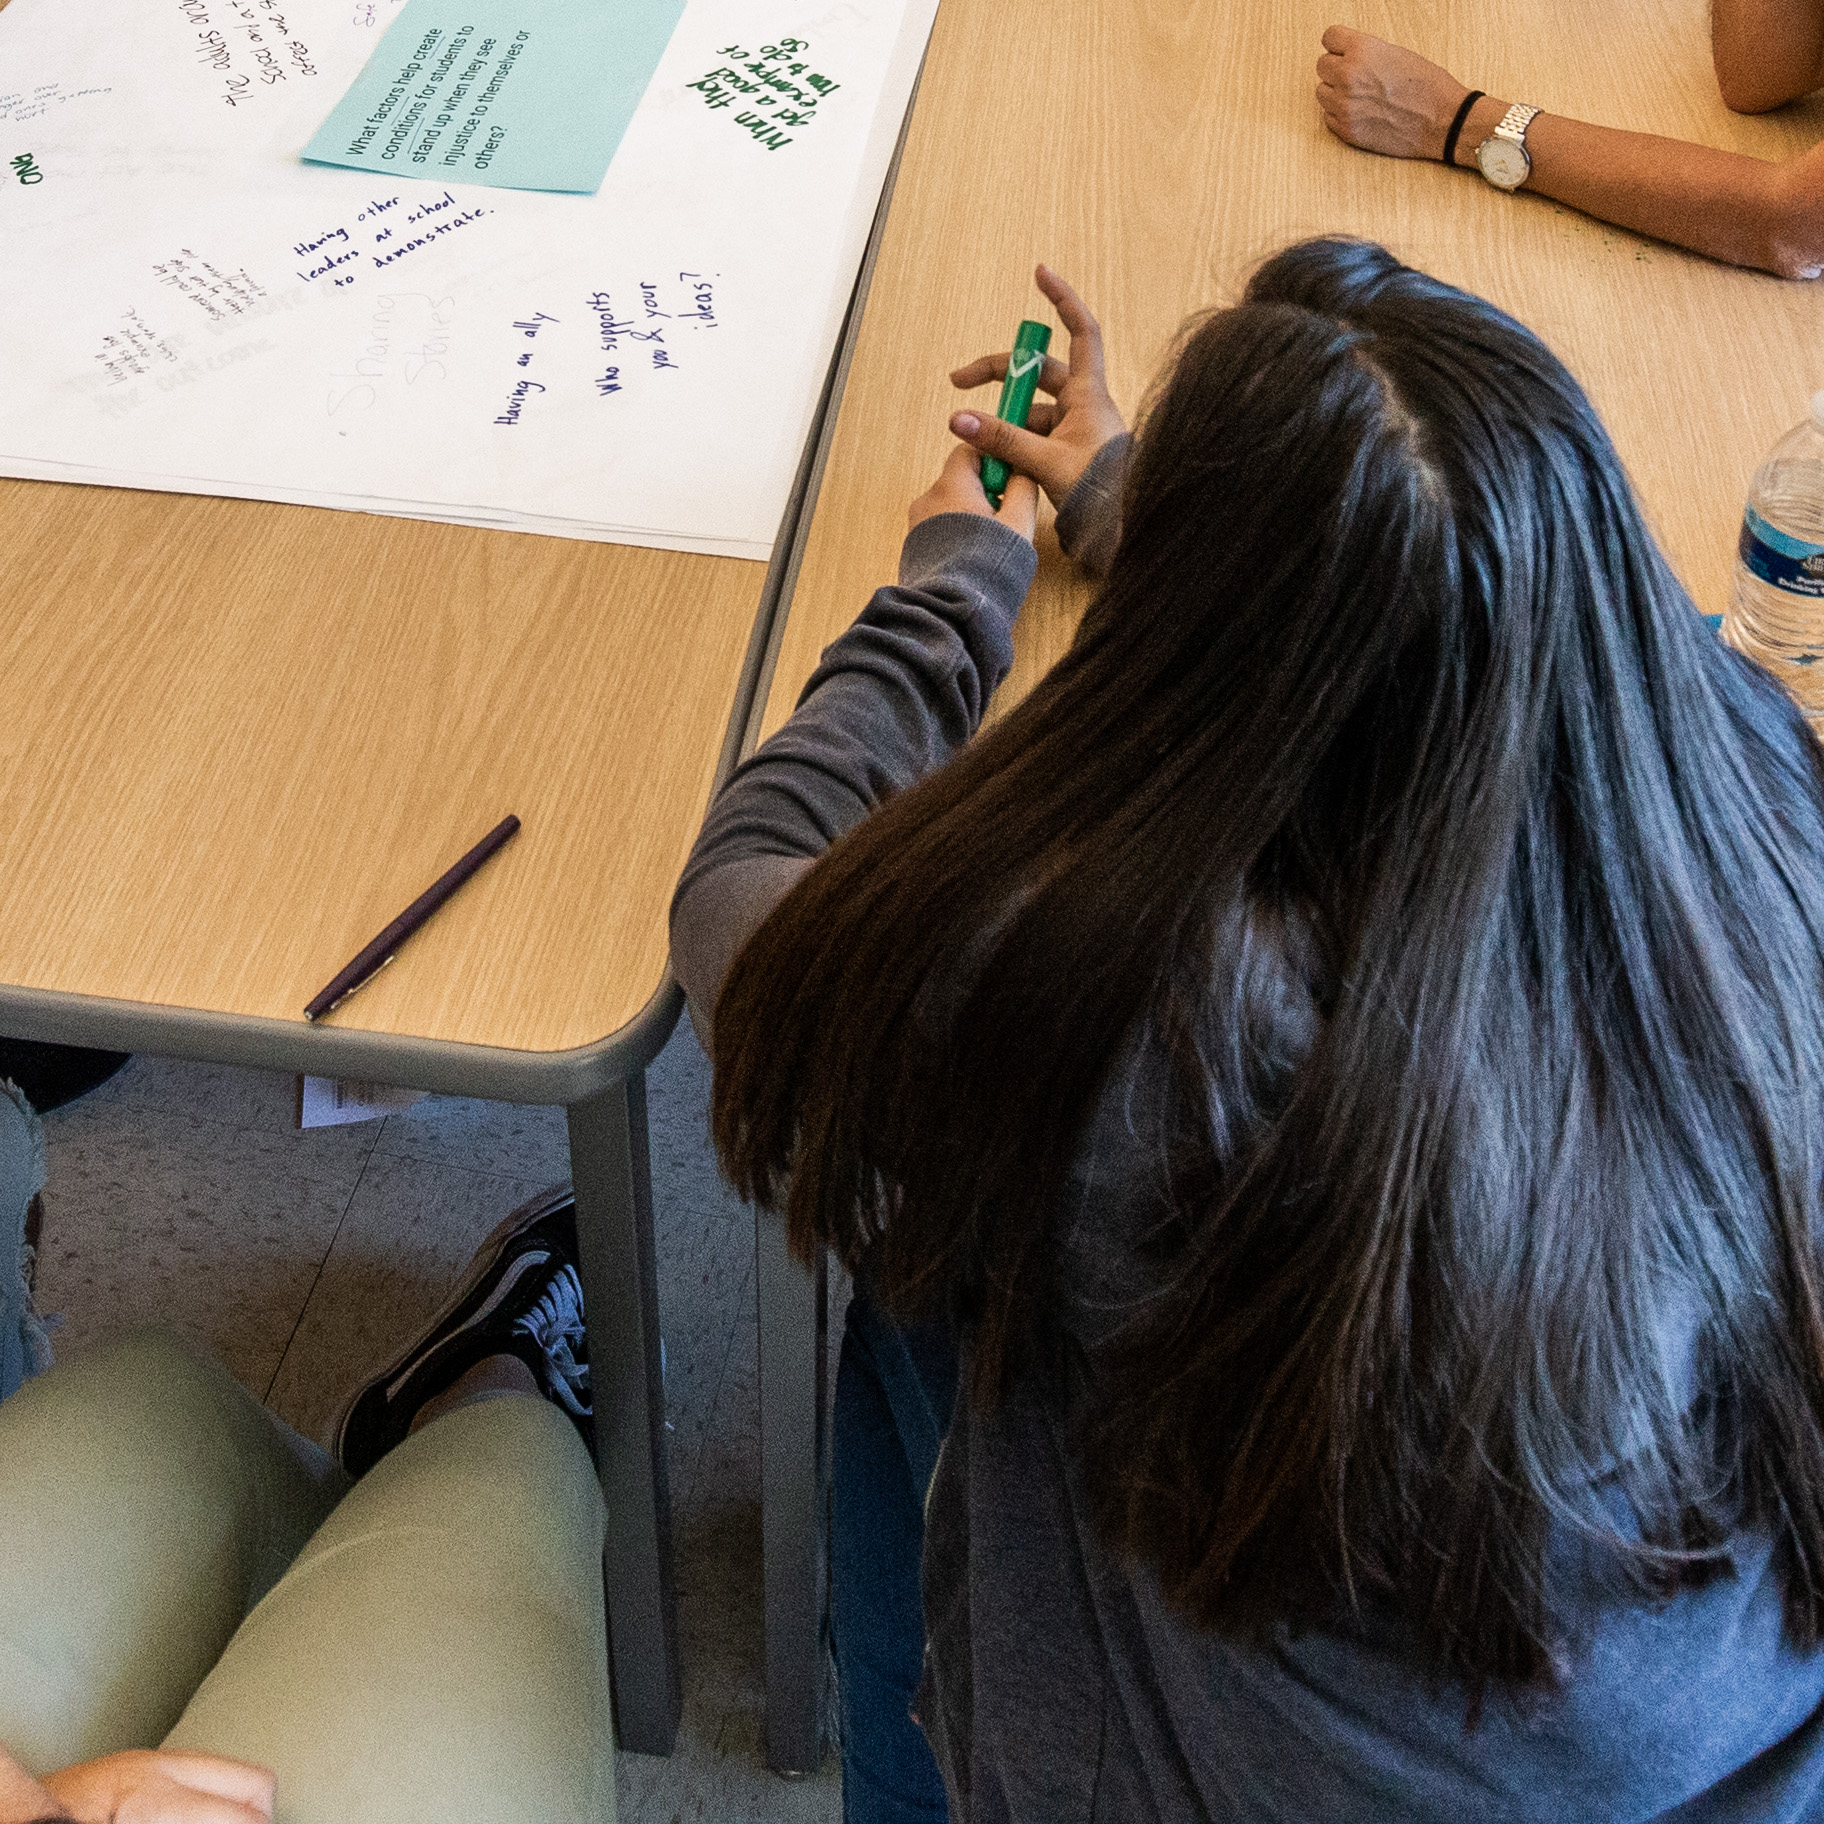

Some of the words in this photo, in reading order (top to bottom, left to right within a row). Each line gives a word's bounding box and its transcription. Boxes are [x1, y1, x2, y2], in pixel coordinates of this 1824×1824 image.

[477, 37, 497, 58] see
[516, 29, 531, 42] or
[346, 125, 378, 155] What
[366, 86, 405, 127] factors
[393, 61, 423, 86] help
[413, 28, 442, 61] create
[381, 101, 427, 160] conditions
[415, 83, 436, 101] for
[430, 37, 467, 83] students
[457, 25, 474, 37] to
[460, 58, 488, 83] they
[478, 42, 524, 105] themselves
[432, 112, 454, 129] up
[442, 84, 471, 112] when
[471, 104, 488, 117] to
[412, 129, 441, 164] stand
[438, 116, 476, 167] injustice
[474, 125, 508, 170] others?
[293, 227, 349, 257] Having
[358, 197, 399, 222] other
[297, 249, 359, 282] leaders
[376, 228, 393, 242] at
[408, 191, 456, 224] school
[334, 275, 354, 286] to
[372, 207, 495, 269] demonstrate.
[585, 291, 635, 351] supports
[639, 281, 672, 319] your
[677, 271, 721, 330] ideas?
[512, 311, 561, 339] ally
[493, 380, 547, 425] Having
[594, 366, 623, 397] Who
